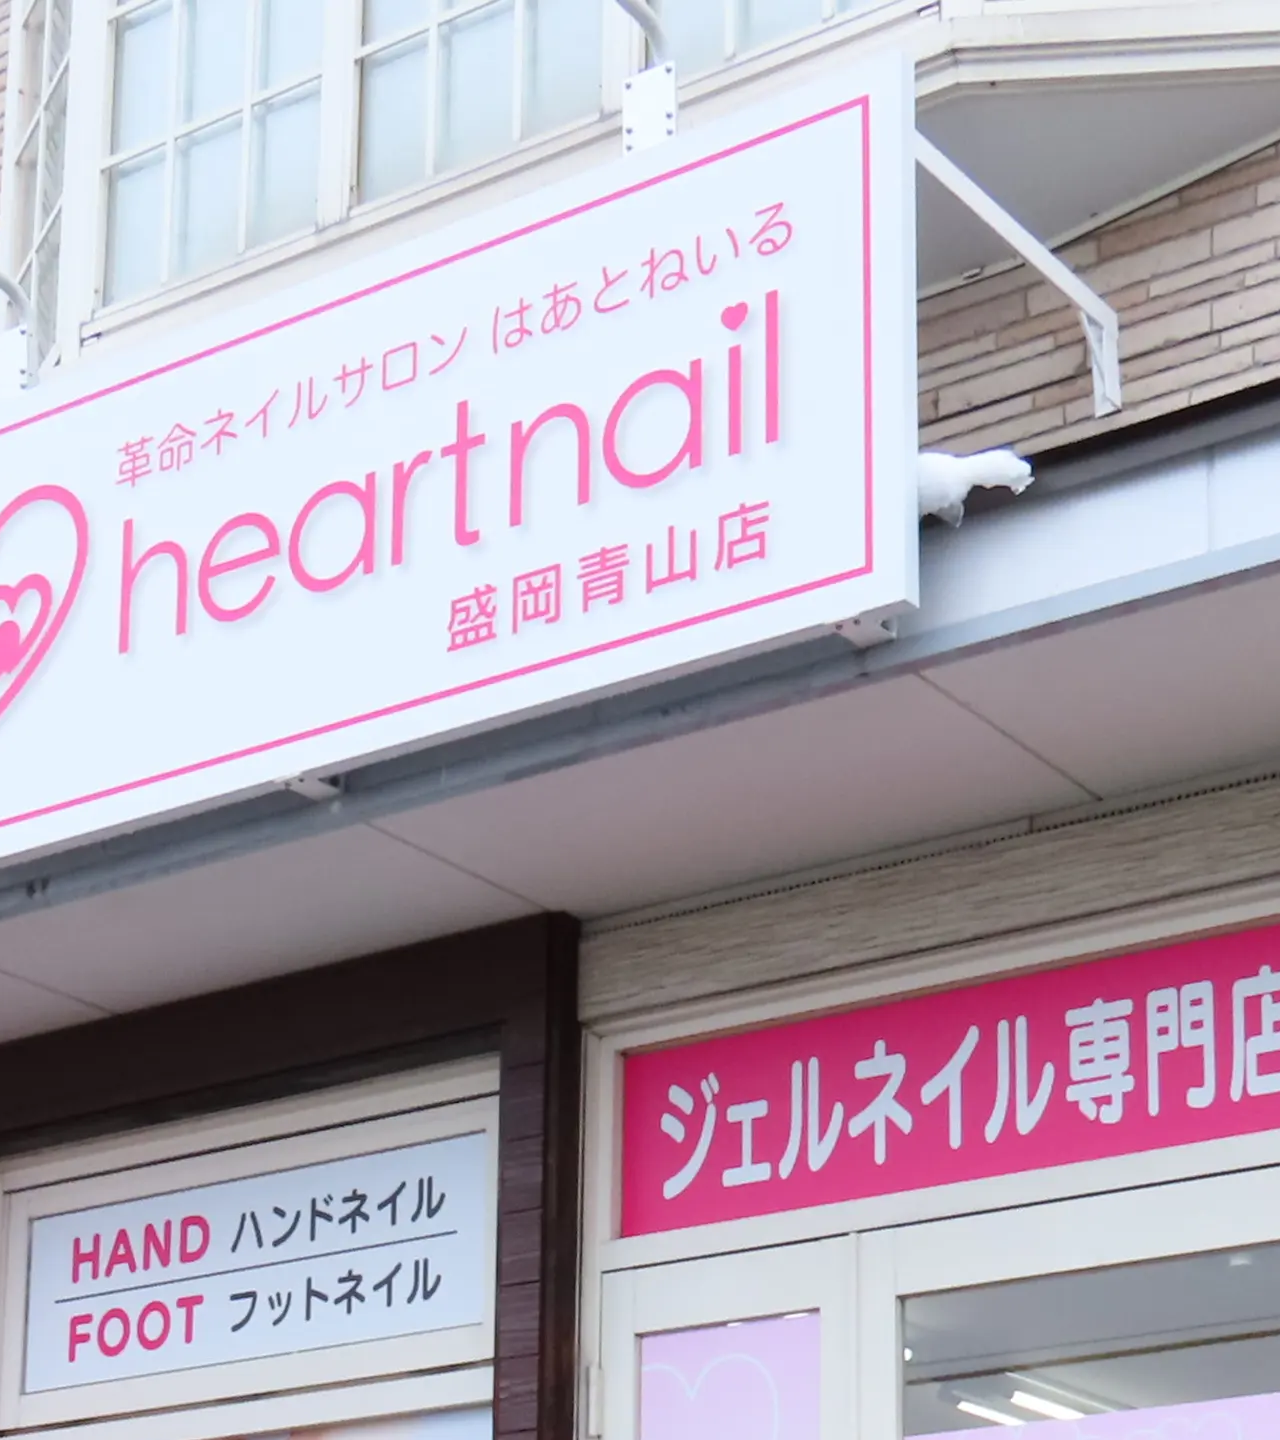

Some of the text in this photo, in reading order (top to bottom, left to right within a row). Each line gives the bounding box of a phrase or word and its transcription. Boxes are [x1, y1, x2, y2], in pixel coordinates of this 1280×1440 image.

[115, 202, 794, 488] 革命ネイルサロン はあとねいる
[118, 289, 779, 654] heartnail
[446, 501, 769, 652] 盛岡青山店
[72, 1175, 445, 1283] HAND ハンドネイル
[68, 1258, 441, 1363] FOOT フットネイル
